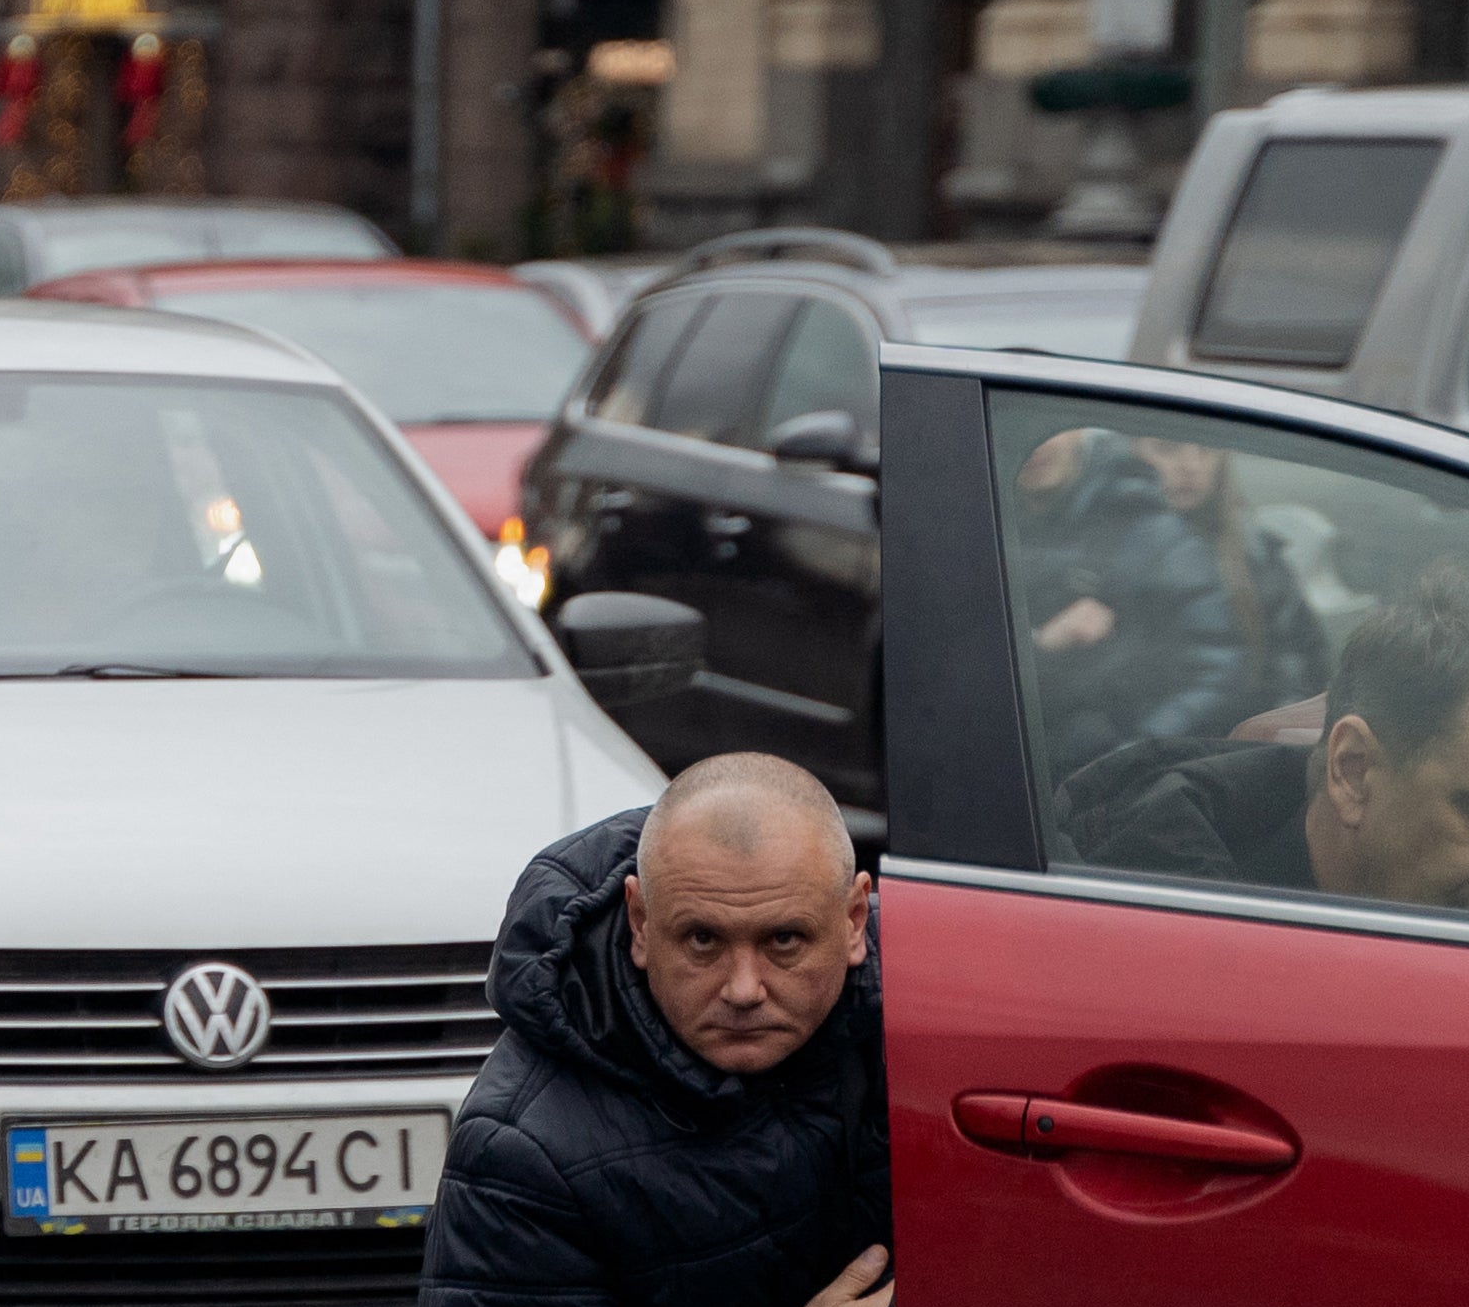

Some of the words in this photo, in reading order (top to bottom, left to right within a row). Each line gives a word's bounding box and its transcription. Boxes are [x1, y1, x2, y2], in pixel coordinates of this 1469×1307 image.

[53, 1138, 149, 1204] KA
[169, 1132, 318, 1197] 6894
[336, 1127, 412, 1193] CI
[16, 1188, 46, 1207] UA
[109, 1214, 227, 1232] ГЕРОЯМ
